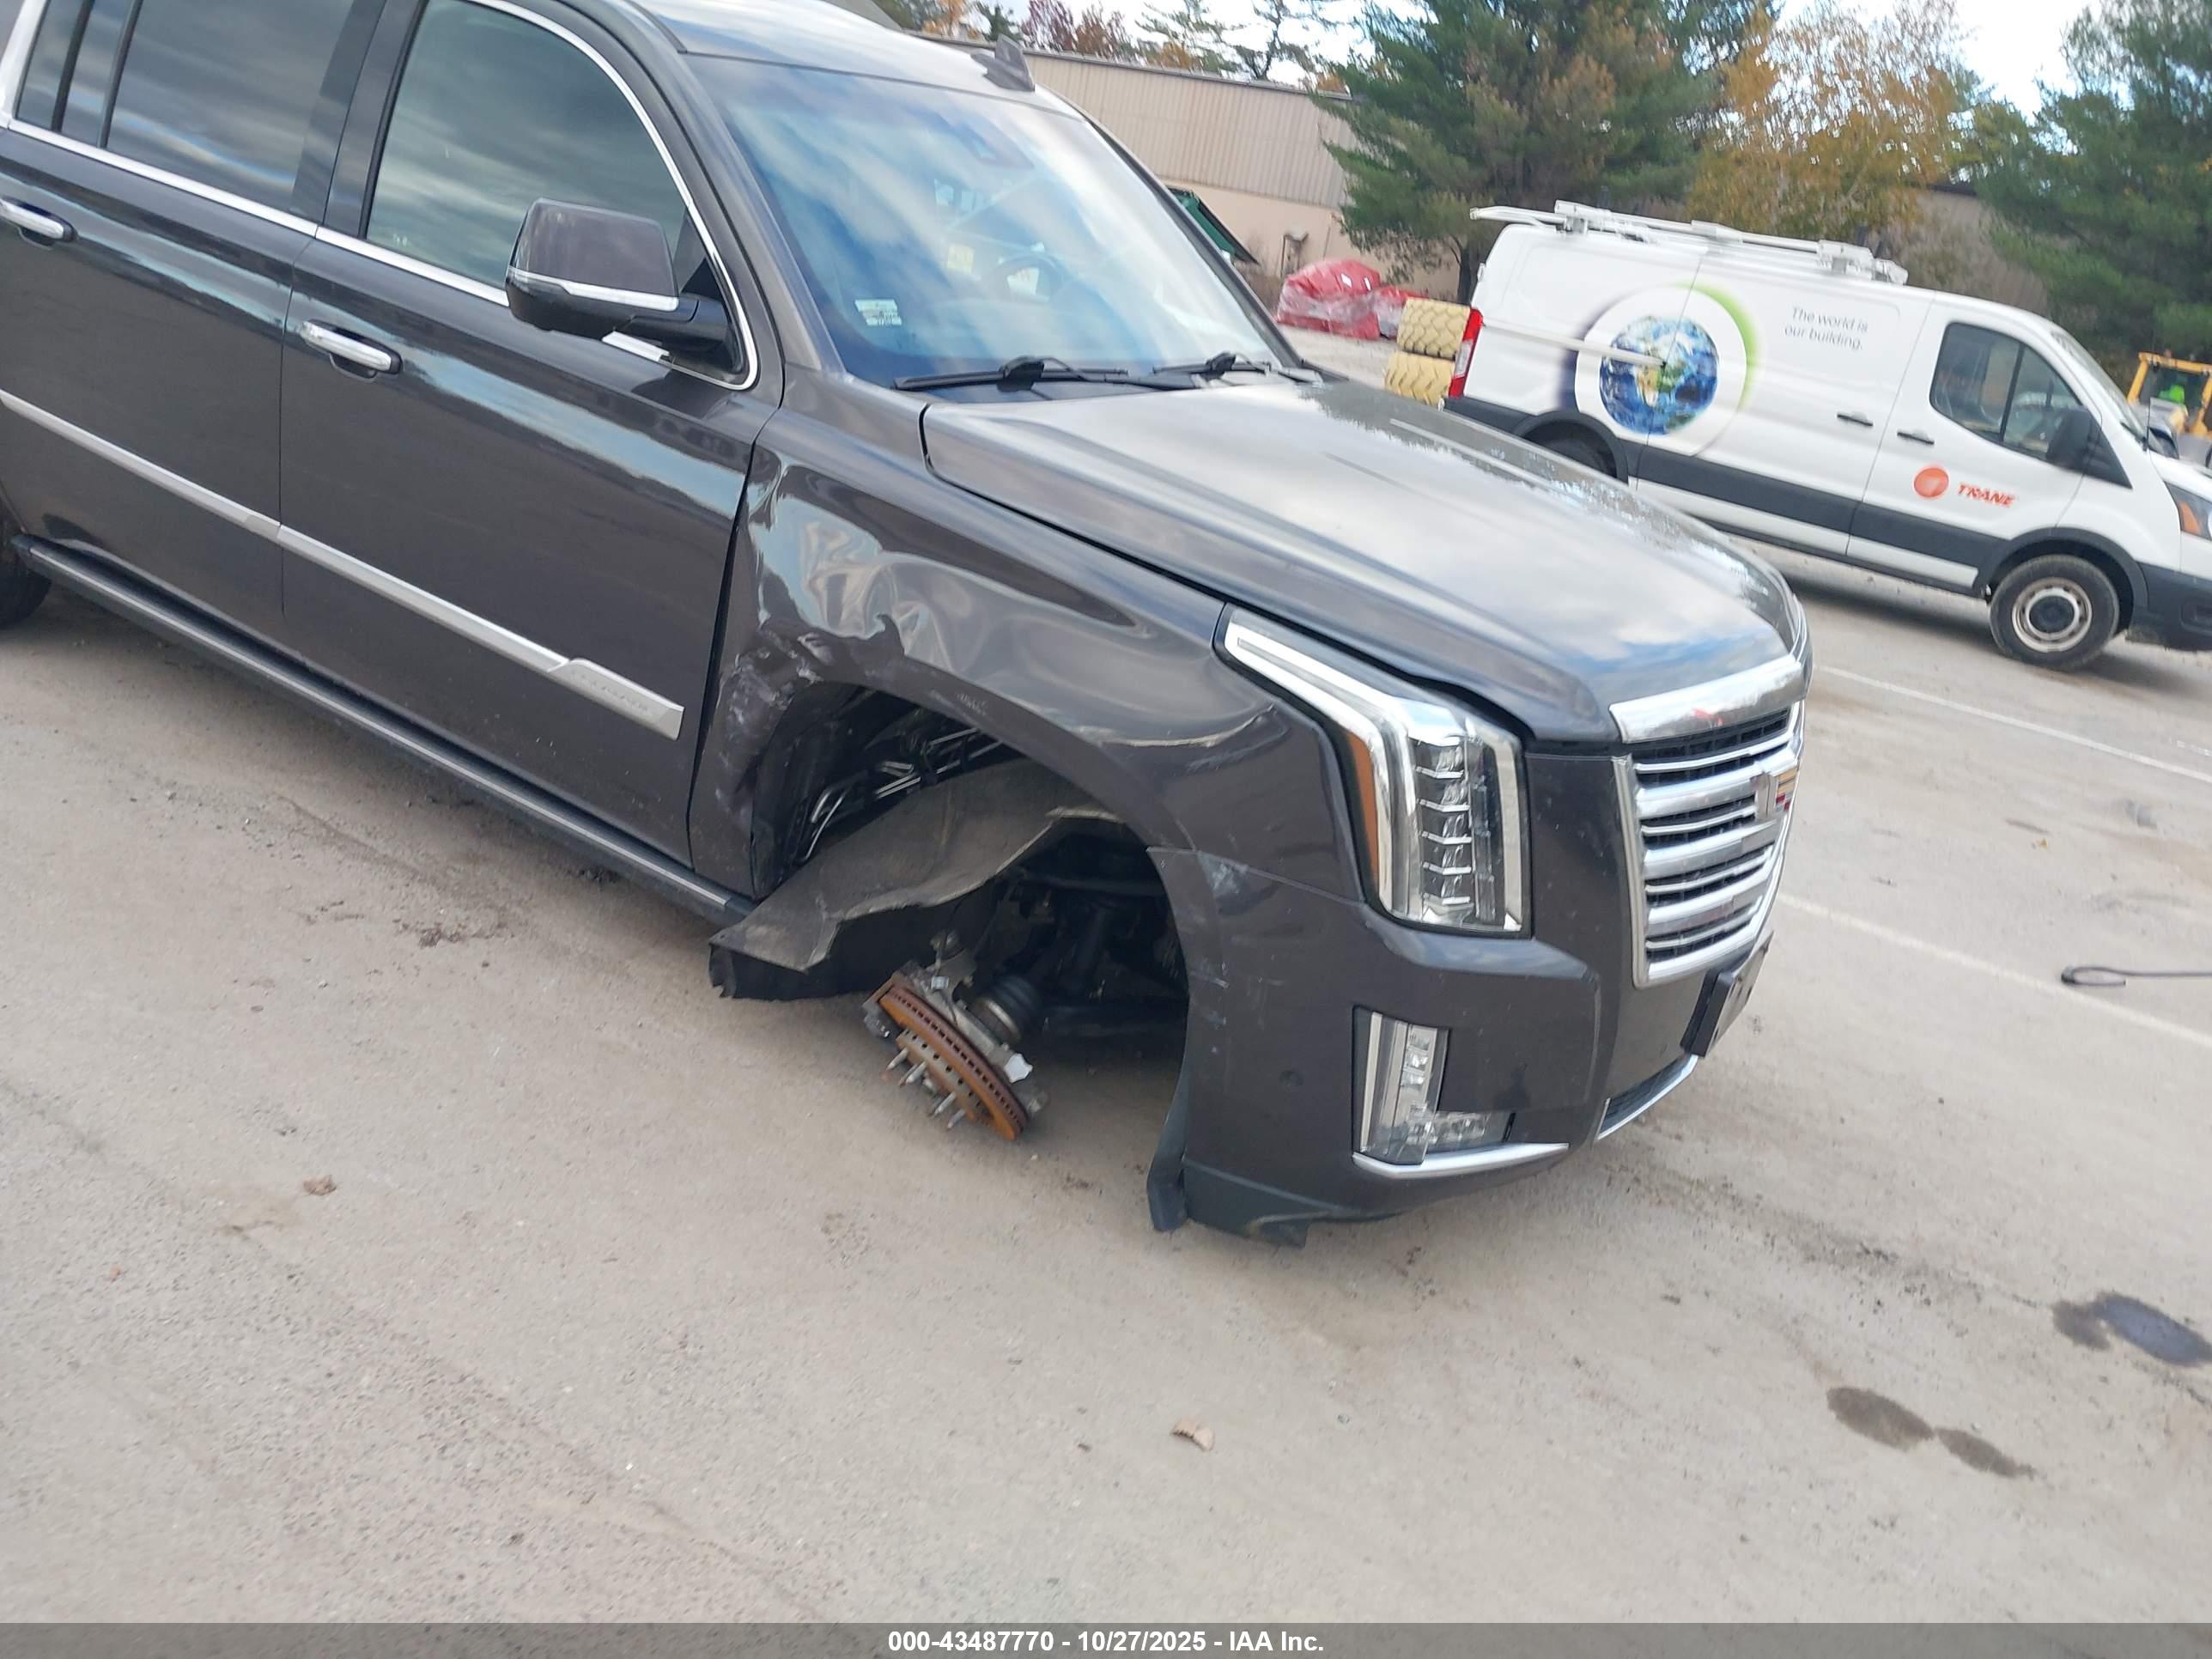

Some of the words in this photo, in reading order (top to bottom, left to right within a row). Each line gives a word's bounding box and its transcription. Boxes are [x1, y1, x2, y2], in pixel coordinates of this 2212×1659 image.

[1784, 324, 1804, 337] our
[1792, 307, 1815, 323] The
[1818, 313, 1856, 330] world
[1856, 319, 1868, 333] is
[1958, 483, 2015, 507] TRANE
